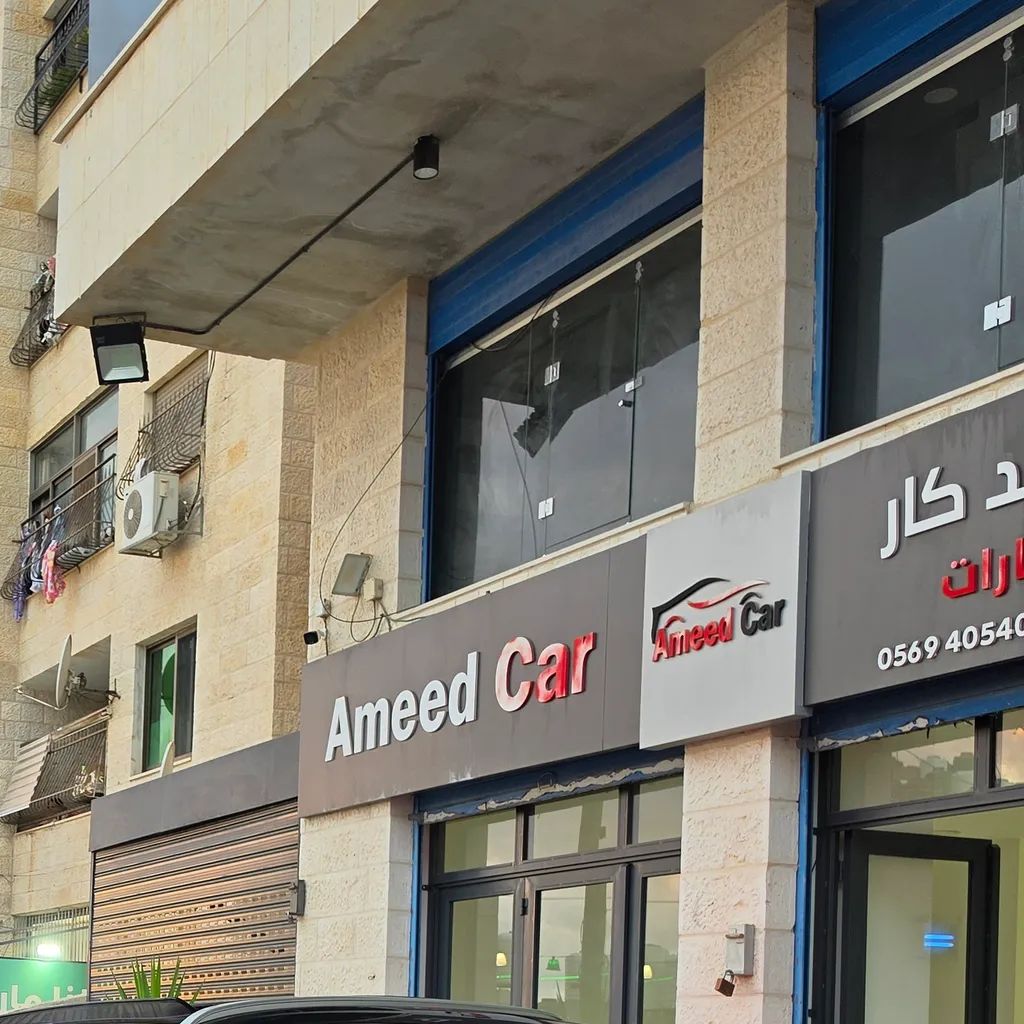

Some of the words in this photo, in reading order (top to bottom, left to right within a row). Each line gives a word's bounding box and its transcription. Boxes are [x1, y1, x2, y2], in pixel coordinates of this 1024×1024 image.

[880, 466, 967, 560] كار
[941, 536, 1024, 598] ارات
[652, 606, 734, 662] Ameed
[740, 597, 786, 636] Car
[877, 635, 941, 671] 0569
[324, 650, 481, 763] Ameed
[494, 631, 597, 713] Car
